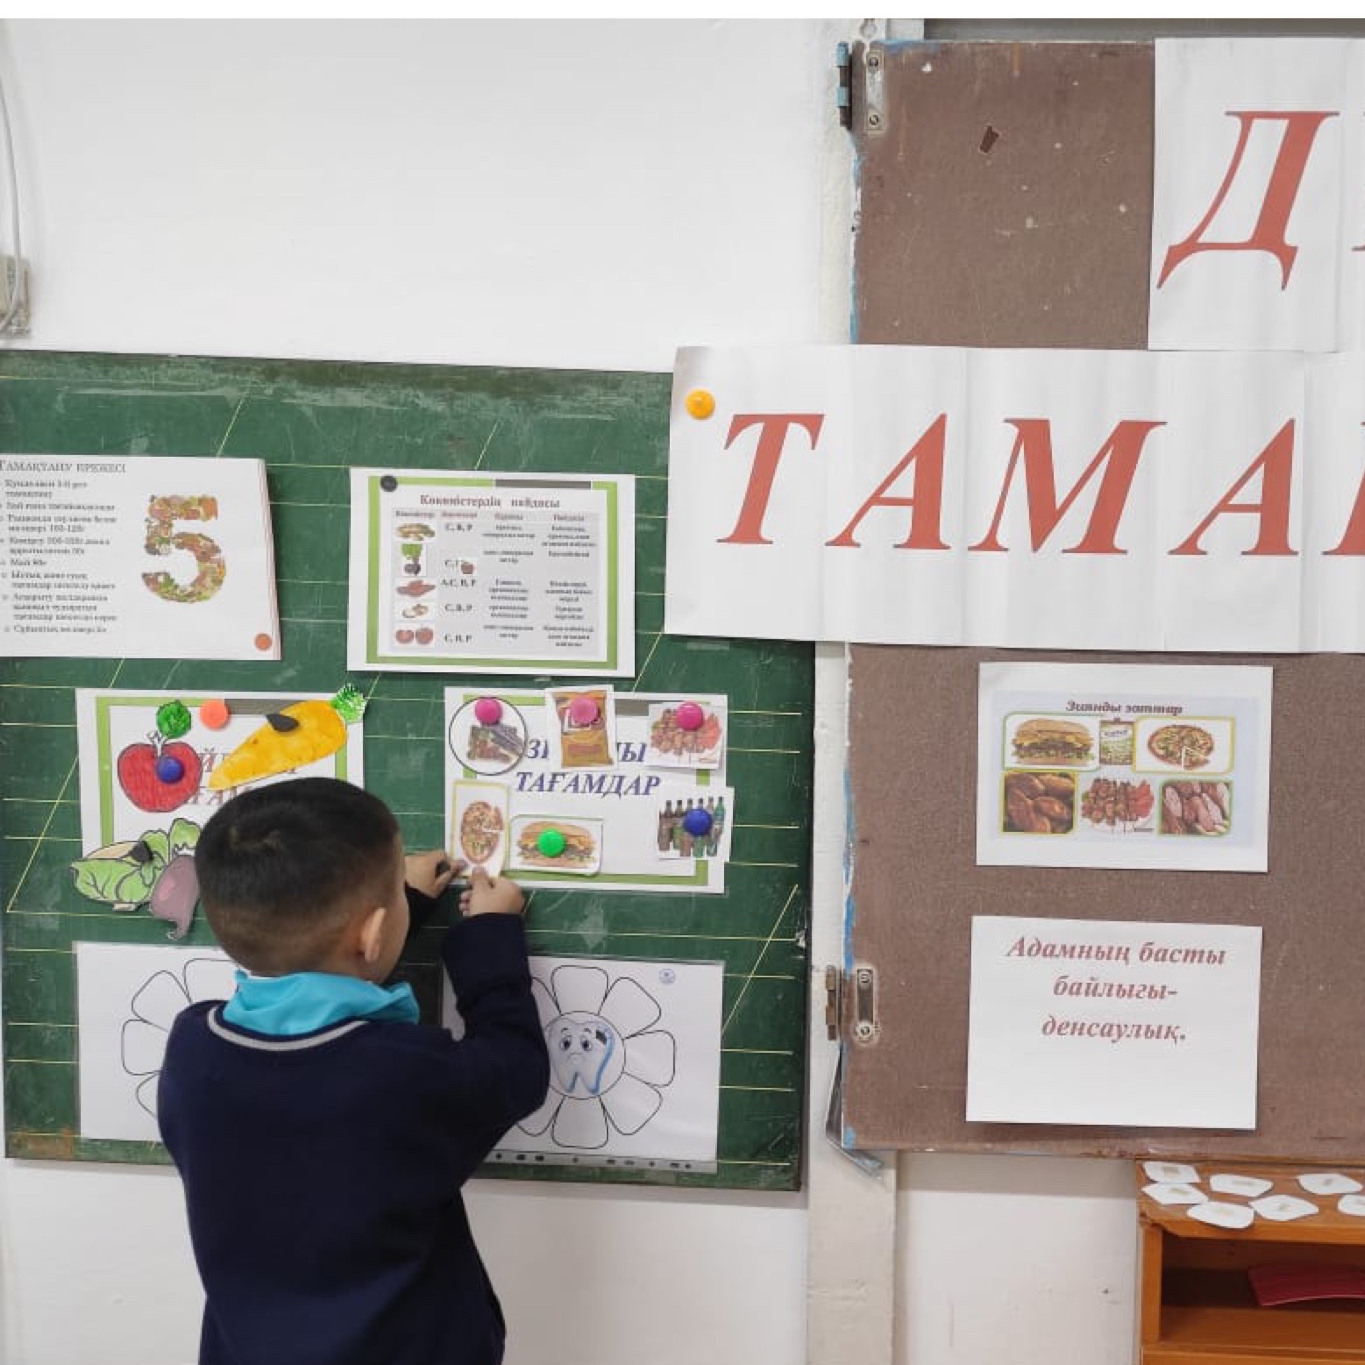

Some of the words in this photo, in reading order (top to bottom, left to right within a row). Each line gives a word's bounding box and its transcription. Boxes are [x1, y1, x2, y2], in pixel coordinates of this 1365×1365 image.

[1065, 701, 1122, 714] Зиянды
[516, 771, 662, 799] ТАҒАМДАР
[1005, 935, 1131, 966] Адамның
[1138, 941, 1227, 966] басты
[1041, 1015, 1187, 1045] денсаулық.
